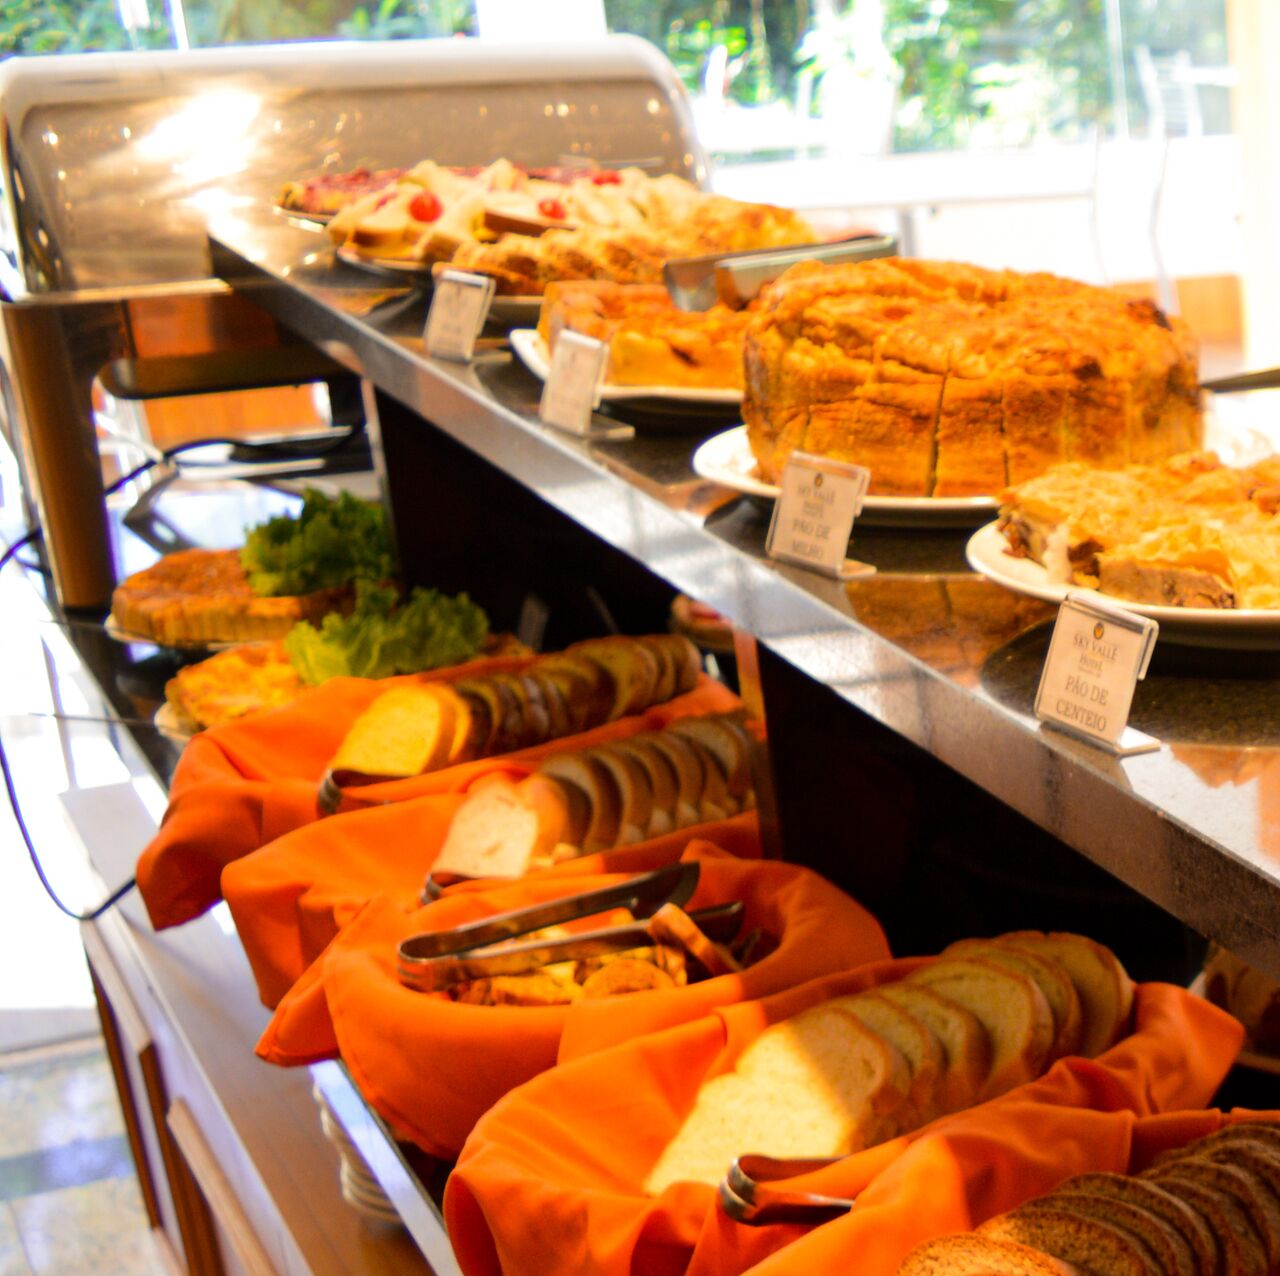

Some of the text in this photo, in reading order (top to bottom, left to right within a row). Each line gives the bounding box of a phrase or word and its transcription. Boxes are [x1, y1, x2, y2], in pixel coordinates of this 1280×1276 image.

[1073, 634, 1090, 649] SKY
[1065, 675, 1109, 705] PÃO DE
[1056, 699, 1107, 733] CENTEIO
